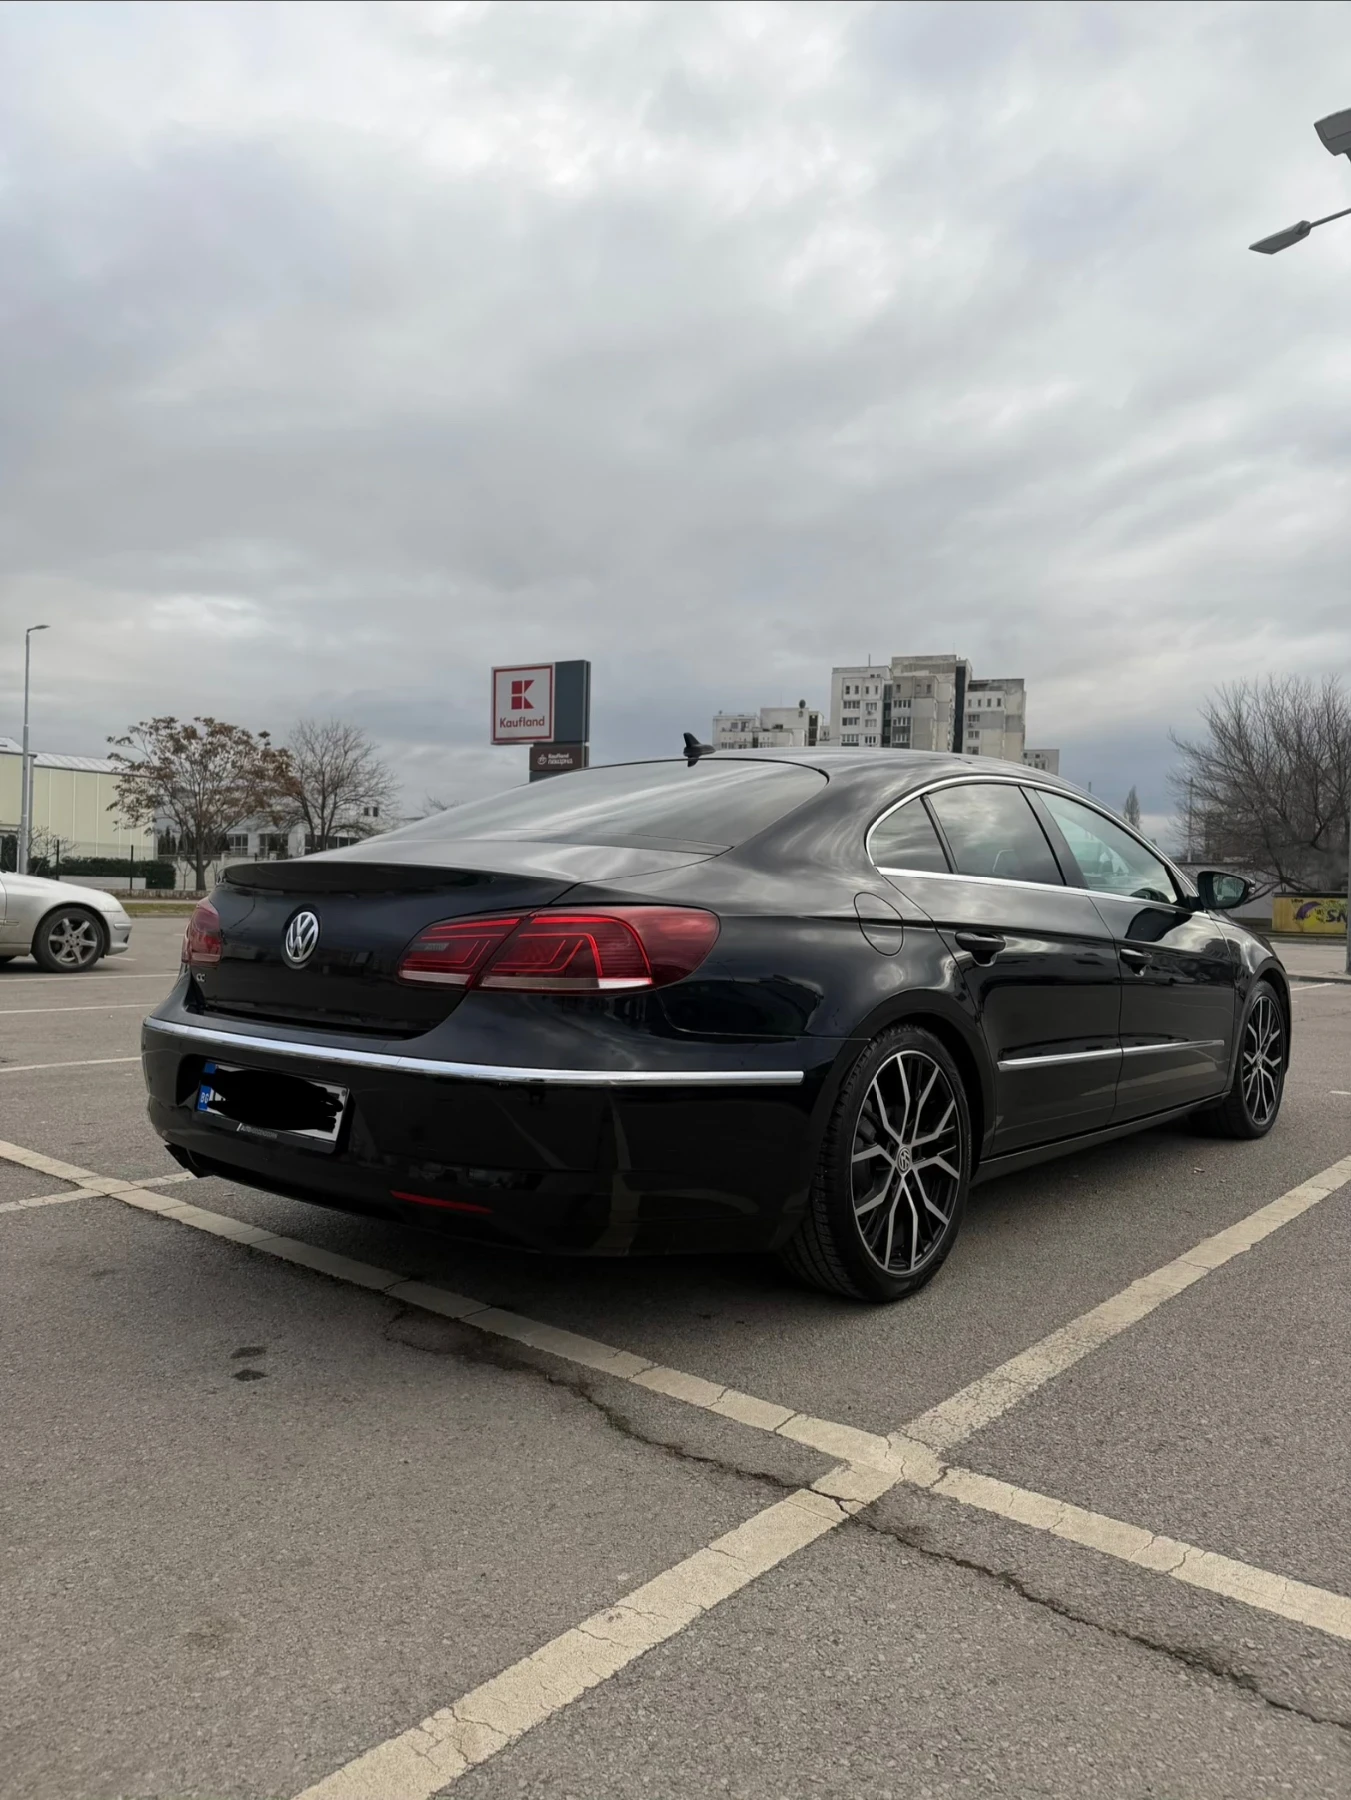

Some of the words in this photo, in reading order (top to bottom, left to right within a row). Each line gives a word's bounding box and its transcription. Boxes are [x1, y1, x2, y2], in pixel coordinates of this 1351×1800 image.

[511, 680, 535, 710] K
[499, 716, 545, 728] Kaufland
[196, 973, 206, 983] CC
[200, 1092, 209, 1104] BG
